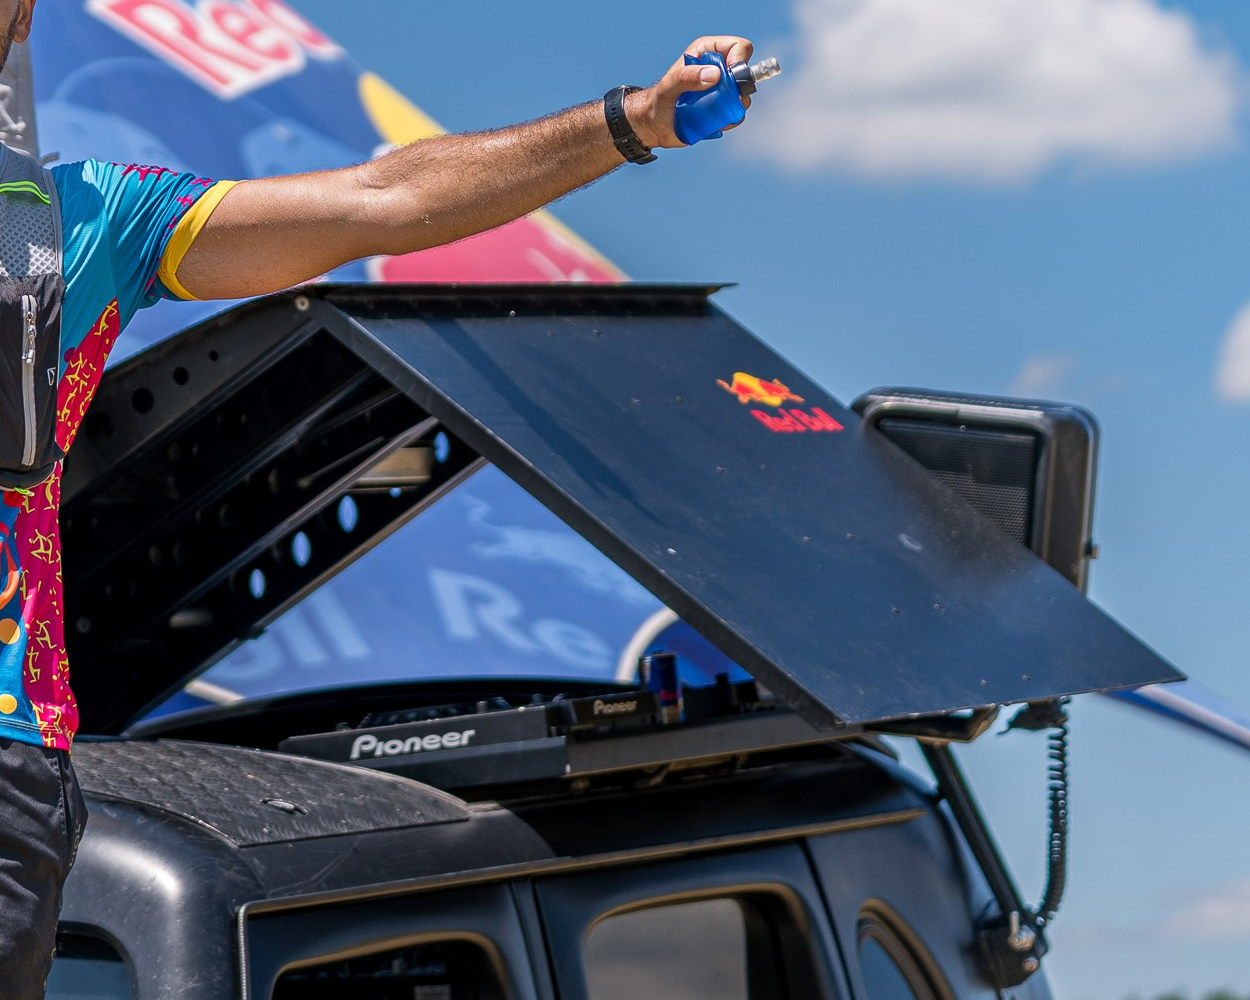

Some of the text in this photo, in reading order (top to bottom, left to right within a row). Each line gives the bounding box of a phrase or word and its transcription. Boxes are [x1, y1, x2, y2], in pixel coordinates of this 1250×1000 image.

[750, 407, 845, 433] Red Bull
[593, 699, 638, 716] Pioneer
[349, 729, 476, 760] Pioneer
